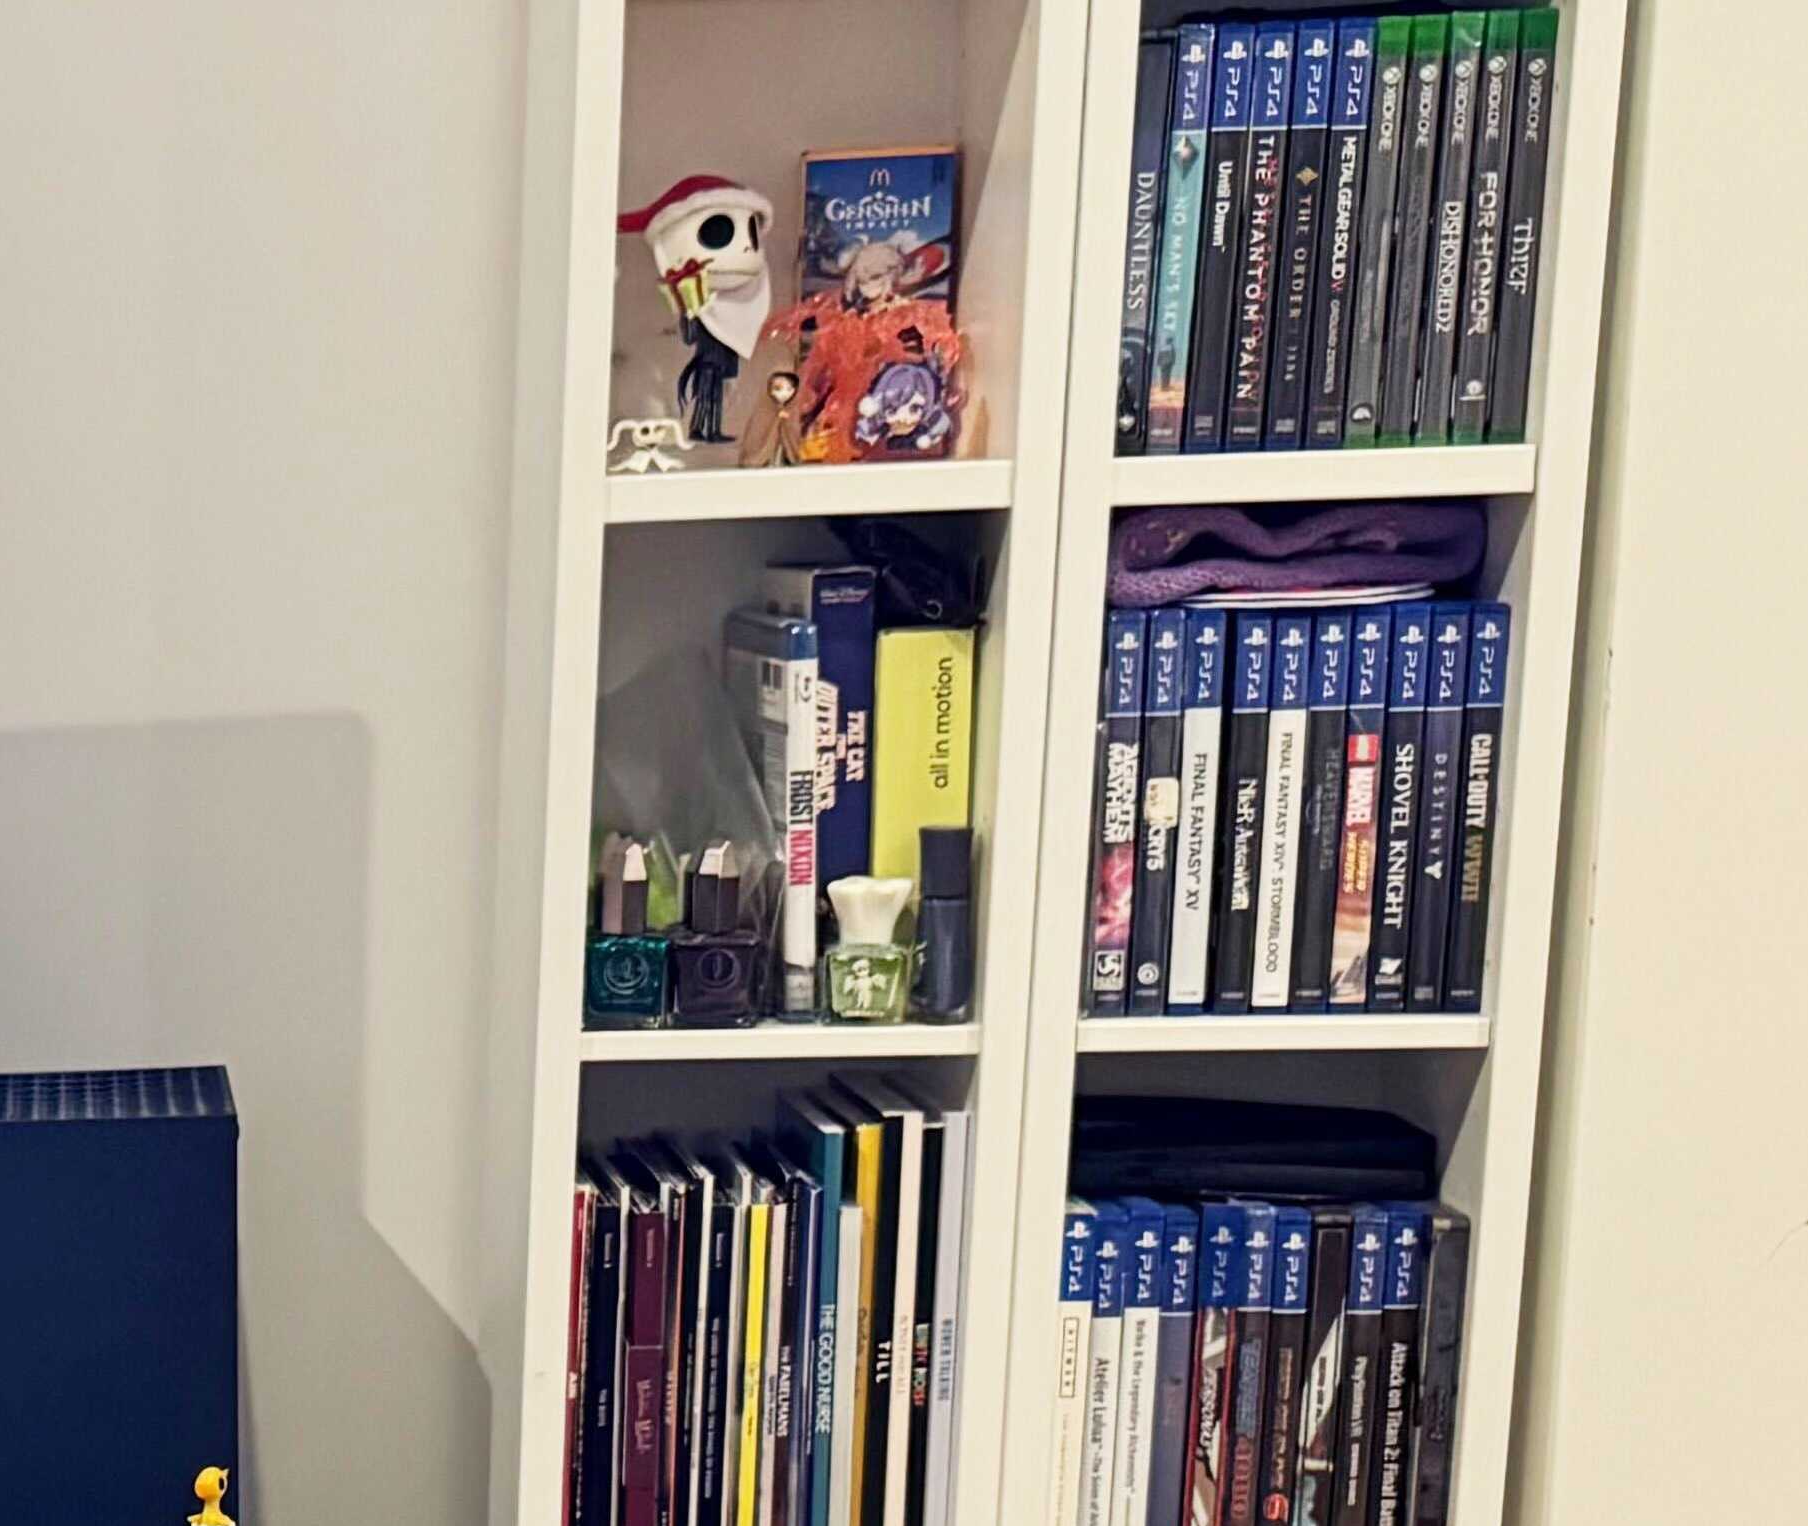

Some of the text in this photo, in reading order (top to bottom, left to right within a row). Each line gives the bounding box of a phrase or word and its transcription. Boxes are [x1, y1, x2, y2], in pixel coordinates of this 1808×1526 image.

[1182, 70, 1200, 121] PS4
[1224, 67, 1242, 118] PS4
[1266, 66, 1284, 118] PS4
[1305, 64, 1323, 115] PS4
[1346, 64, 1363, 117] PS4
[825, 193, 932, 221] GENSHIN
[1126, 171, 1155, 310] DAUNTLESS
[1236, 135, 1275, 399] THE PHANTOM PAIN
[1289, 196, 1311, 319] THE ORDER
[1120, 657, 1134, 704] PS4
[846, 711, 867, 783] THE CAT
[929, 656, 953, 789] all in motion
[1104, 742, 1122, 844] MAYHEM
[1194, 753, 1208, 800] FINAL
[1429, 754, 1447, 855] DESTINY
[789, 769, 814, 886] FROST NIXON
[1264, 732, 1293, 973] FINAL FANTASY STORMBLOOD
[1383, 743, 1415, 930] SHOVEL KNIGHT
[1185, 889, 1199, 911] XV
[815, 1303, 837, 1434] THE GOOD NURSE
[876, 1342, 893, 1383] TILL
